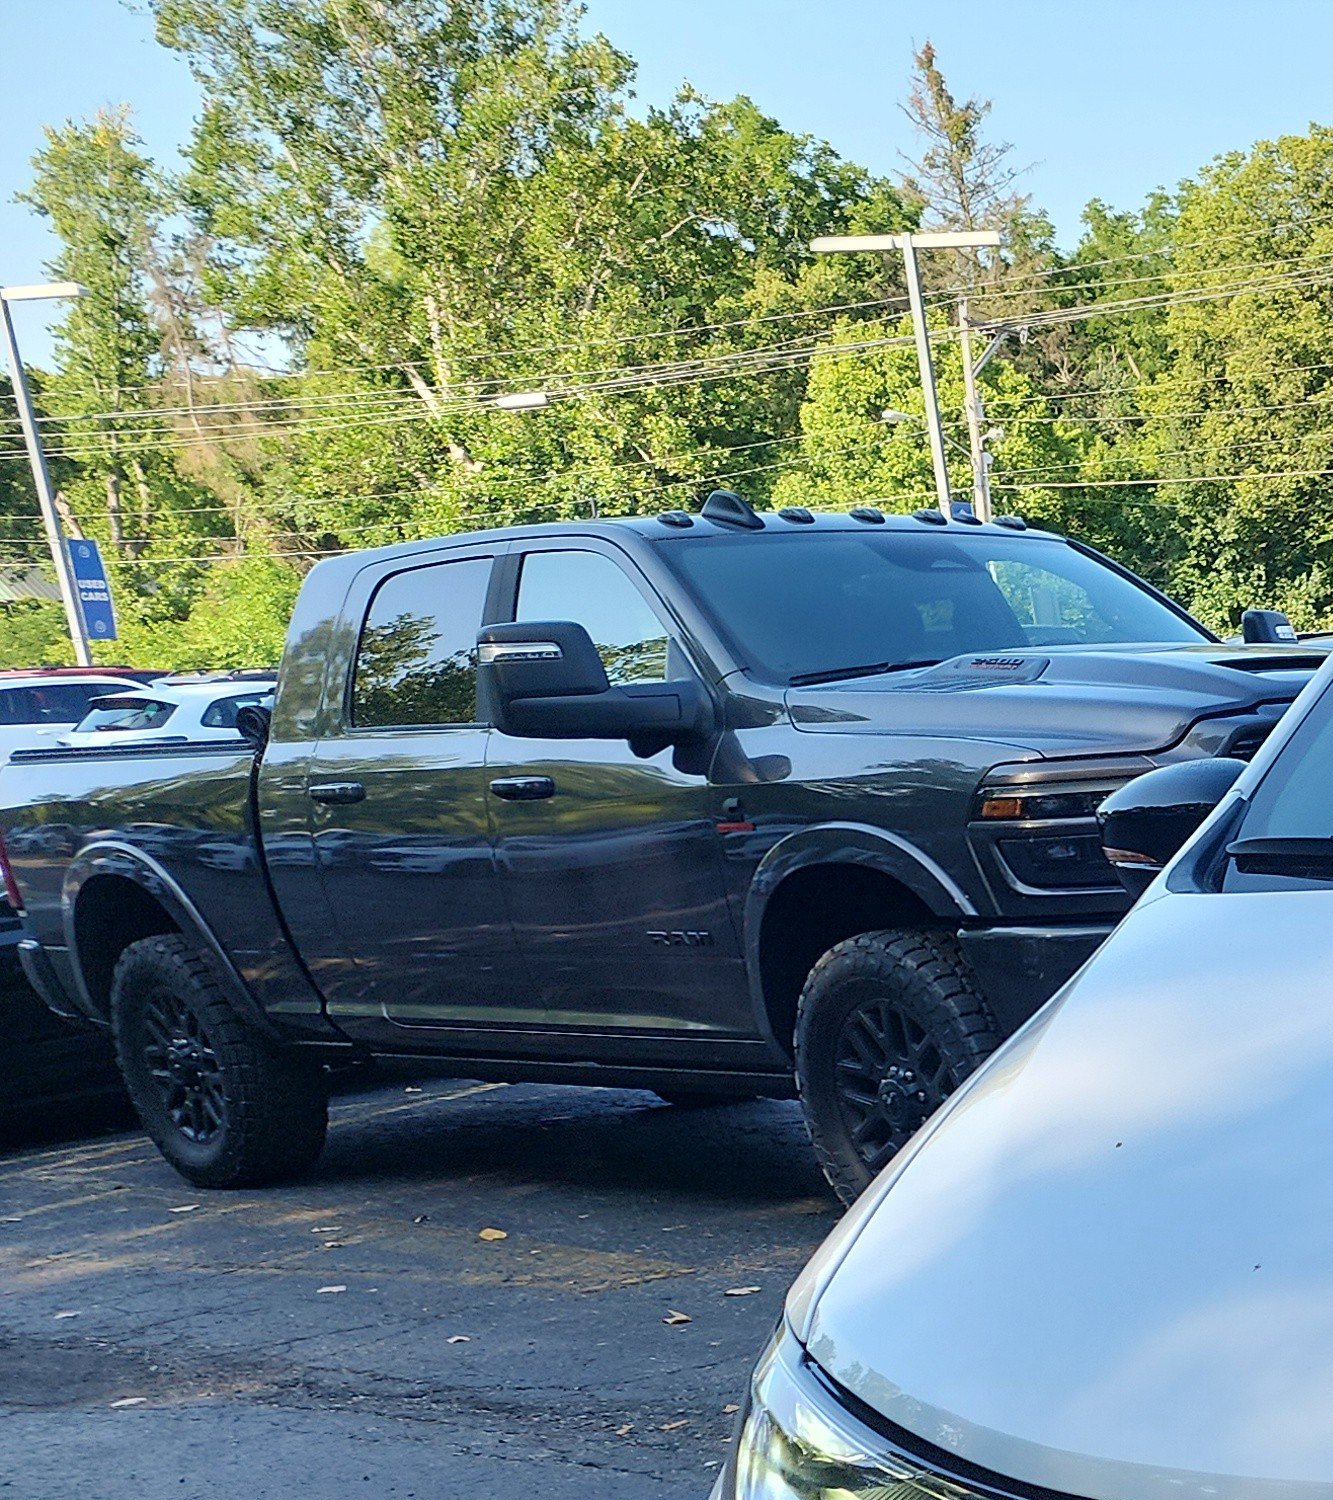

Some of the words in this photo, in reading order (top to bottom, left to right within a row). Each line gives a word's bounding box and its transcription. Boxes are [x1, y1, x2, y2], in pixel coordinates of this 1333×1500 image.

[78, 580, 106, 589] USED
[80, 592, 109, 601] CARS
[646, 930, 713, 945] RAM
